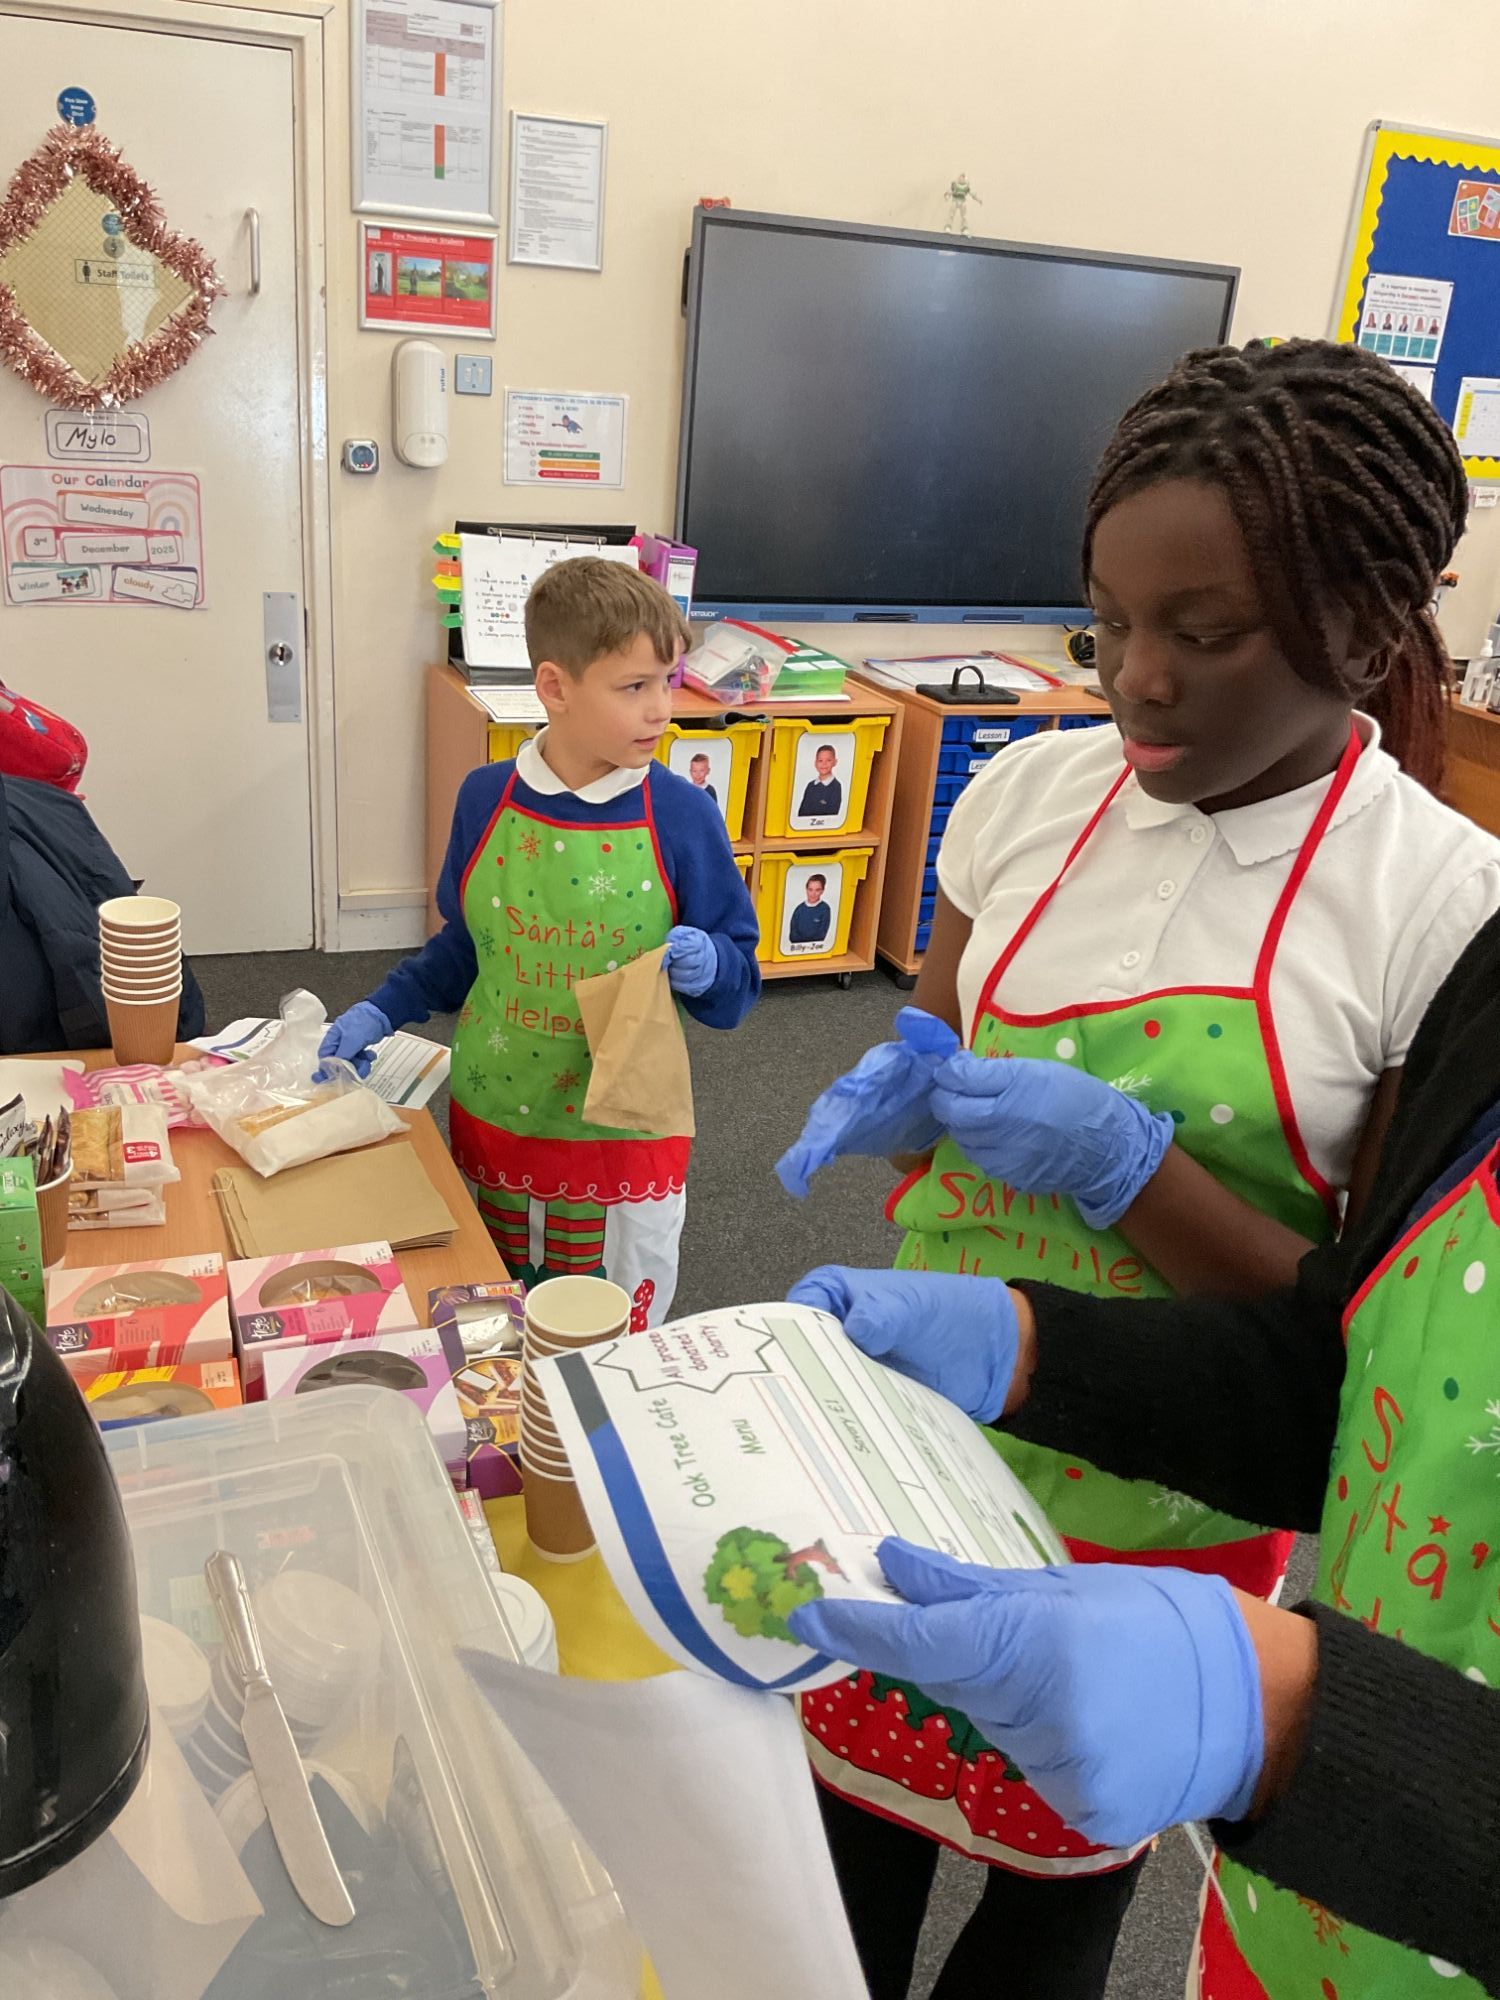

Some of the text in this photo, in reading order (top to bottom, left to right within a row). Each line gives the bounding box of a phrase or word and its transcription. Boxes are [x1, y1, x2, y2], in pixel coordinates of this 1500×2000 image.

[65, 427, 117, 450] Mylo
[51, 474, 150, 488] Our Calendar
[80, 503, 134, 519] Wednesday
[81, 544, 130, 554] December
[151, 545, 175, 555] 2025
[18, 581, 50, 591] Winter
[124, 577, 154, 591] cloudy
[978, 731, 1002, 739] Lesson
[810, 818, 825, 826] Zac
[506, 905, 625, 949] Santa's
[516, 953, 607, 991] Littl
[505, 997, 586, 1039] Helpe
[649, 1331, 685, 1379] All procee
[671, 1333, 708, 1371] donated
[699, 1325, 729, 1358] charity
[731, 1419, 767, 1454] Menu
[670, 1433, 697, 1470] Tree
[681, 1472, 716, 1507] Oak
